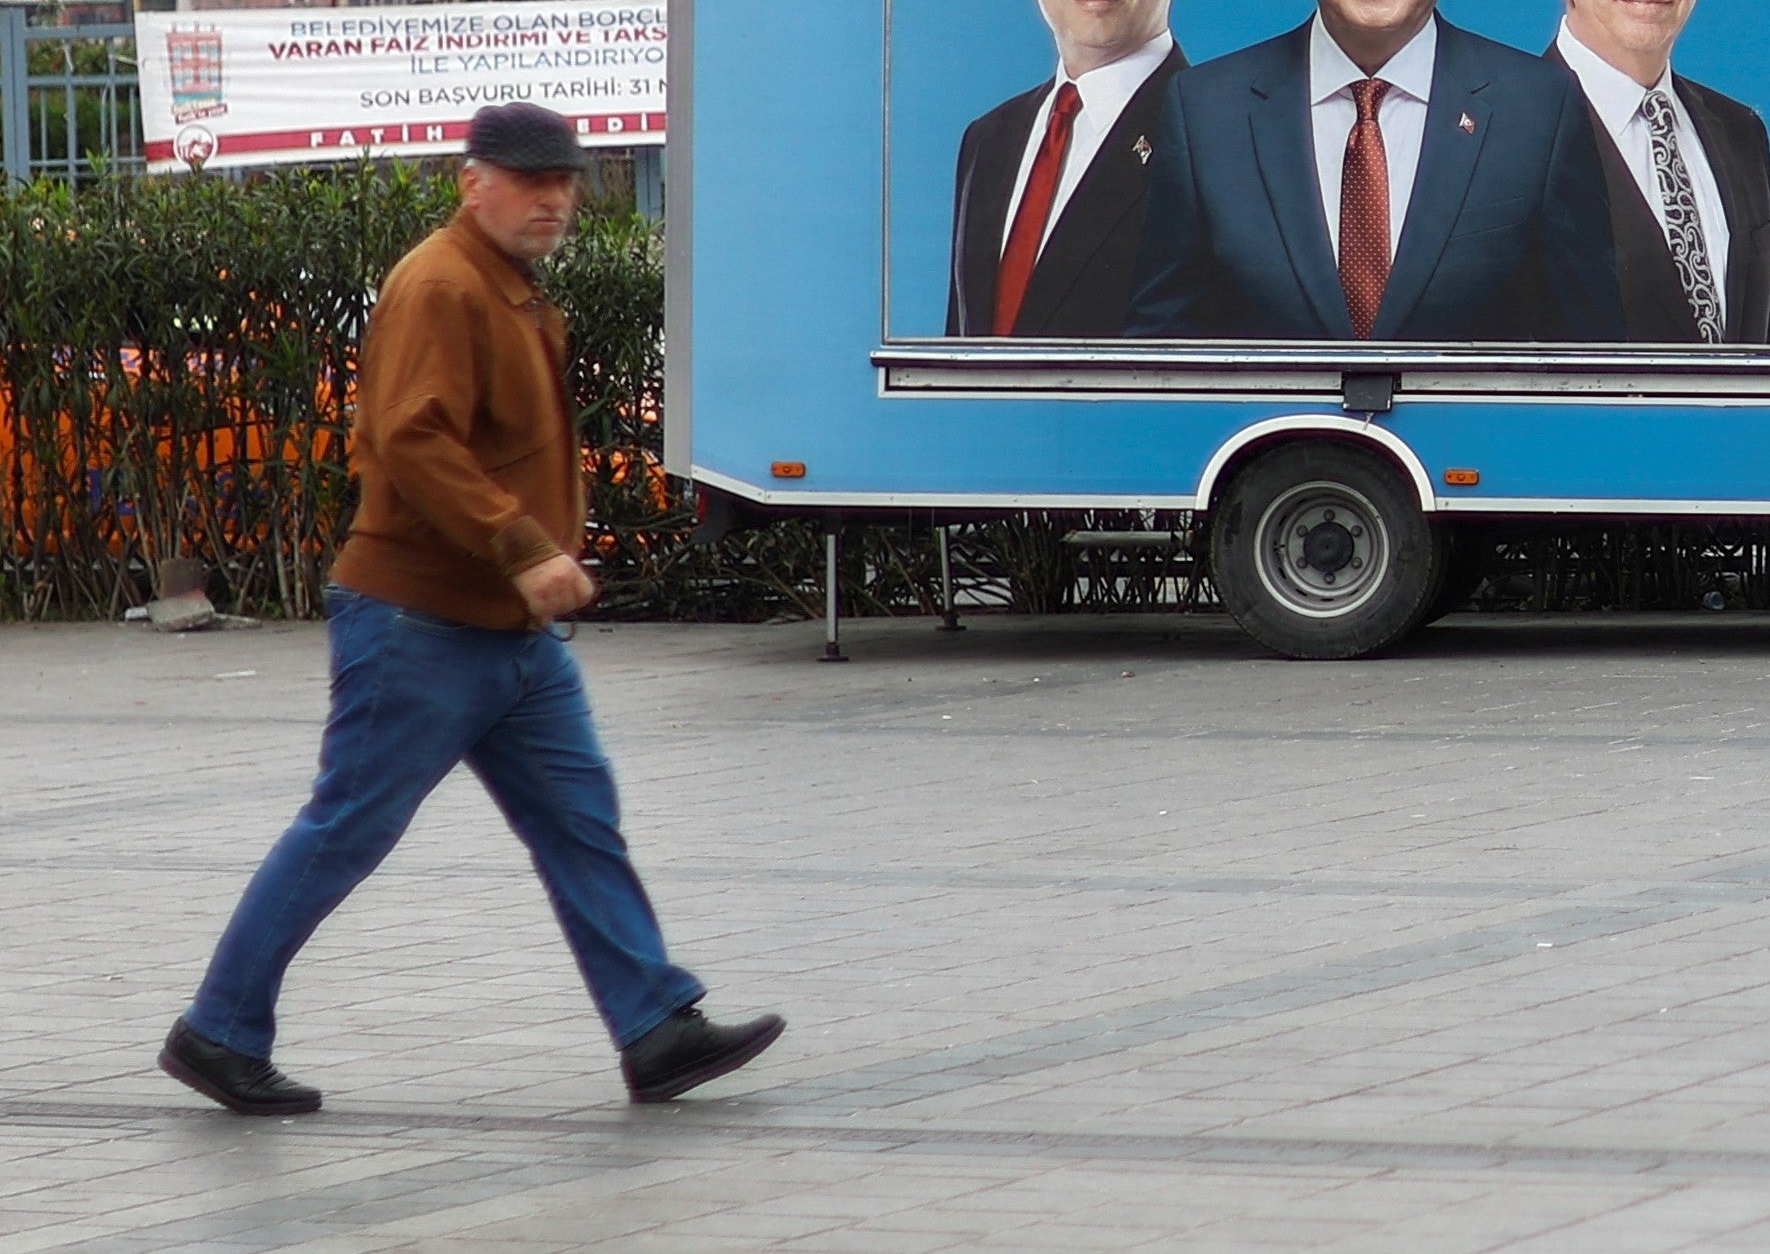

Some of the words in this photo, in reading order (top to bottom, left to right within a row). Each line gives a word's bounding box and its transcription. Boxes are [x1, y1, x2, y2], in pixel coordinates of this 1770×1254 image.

[493, 12, 570, 32] OLAN
[579, 7, 667, 30] BORÇL
[268, 37, 363, 60] VARAN
[557, 29, 591, 45] VE
[602, 25, 667, 43] TAKS
[411, 53, 450, 76] İLE
[458, 46, 665, 72] YAPILANDIRIYO
[360, 90, 411, 108] SON
[418, 83, 532, 104] BAŞVURU
[630, 78, 651, 96] 31
[310, 124, 443, 148] FATİH
